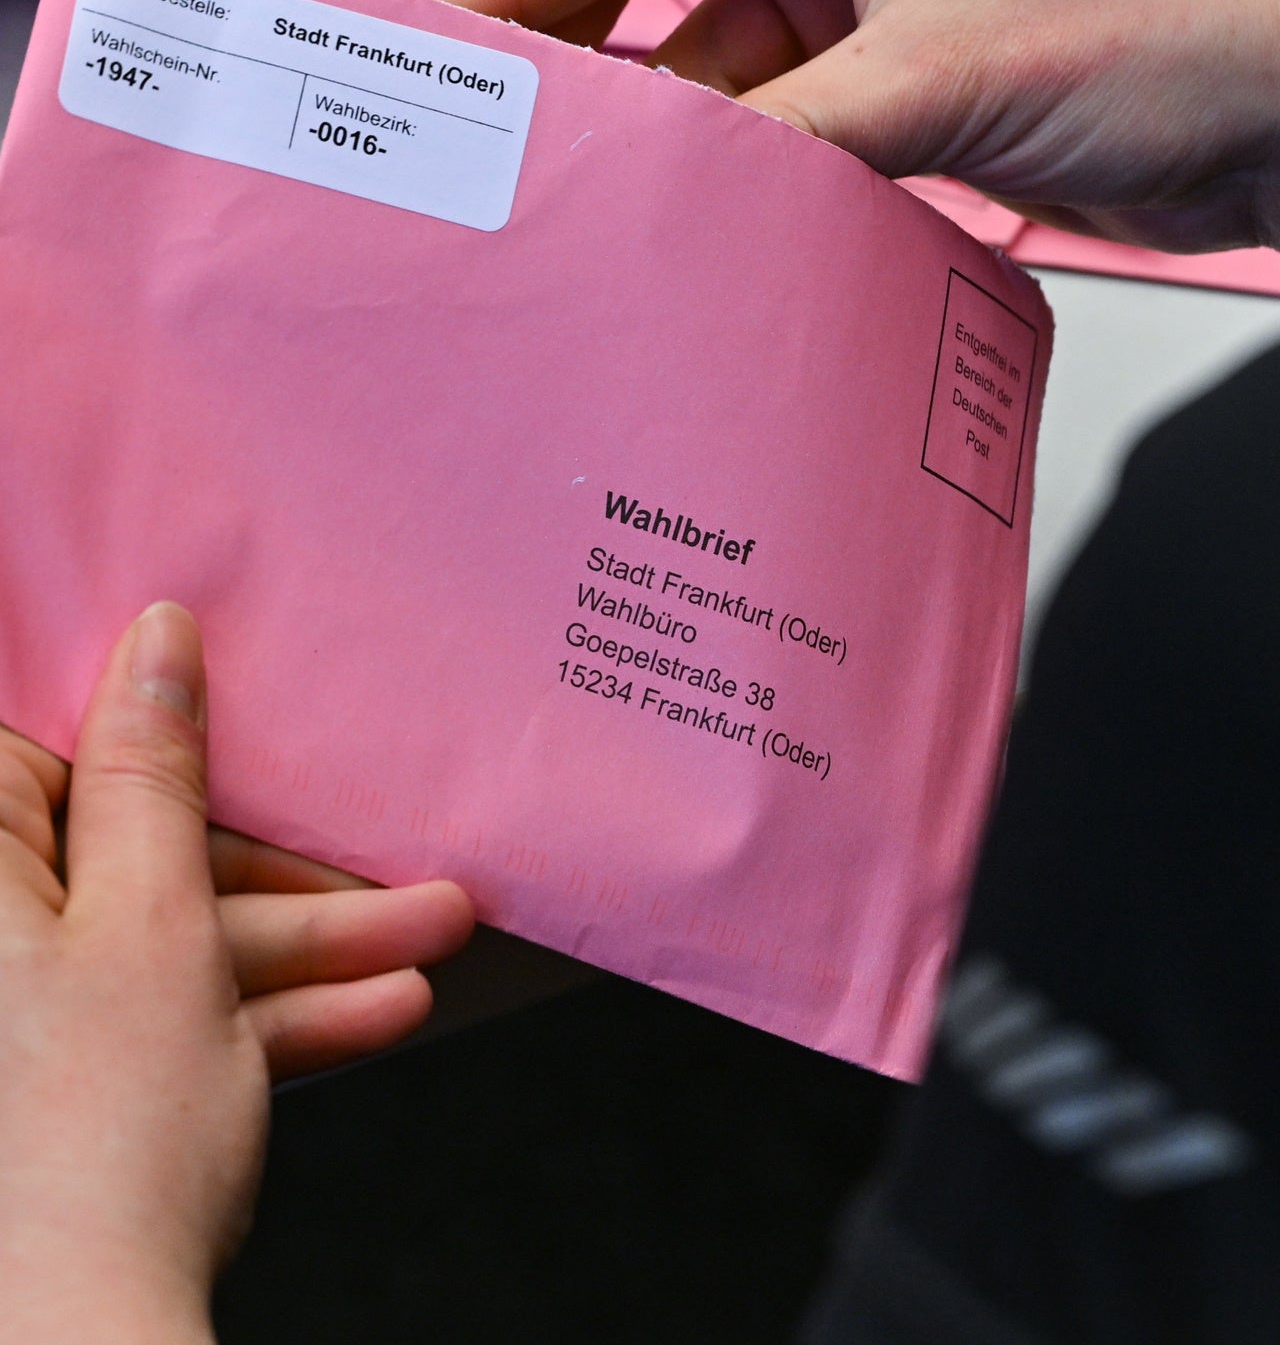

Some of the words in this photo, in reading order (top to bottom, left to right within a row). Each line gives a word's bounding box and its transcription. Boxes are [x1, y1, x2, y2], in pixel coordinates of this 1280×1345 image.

[85, 57, 160, 91] -1947-
[91, 28, 221, 83] Wahlschein-Nr.
[273, 18, 330, 48] Stadt
[335, 35, 434, 77] Frankfurt
[438, 63, 506, 101] (Oder)
[308, 122, 388, 155] -0016-
[315, 94, 417, 136] Wahlbezirk:
[954, 322, 1008, 371] Entgeltfrei
[1008, 362, 1021, 383] im
[955, 355, 996, 396] Bereich
[997, 388, 1014, 410] der
[952, 387, 1008, 439] Deutschen
[965, 428, 991, 460] Post
[605, 491, 757, 565] Wahlbrief
[578, 583, 697, 643] Wahlbüro
[587, 547, 656, 590] Stadt
[662, 571, 774, 631] Frankfurt
[780, 614, 847, 667] (Oder)
[566, 623, 738, 697] Goepelstraße
[745, 682, 776, 711] 38
[558, 660, 633, 704] 15234
[641, 687, 757, 746] Frankfurt
[762, 729, 831, 782] (Oder)
